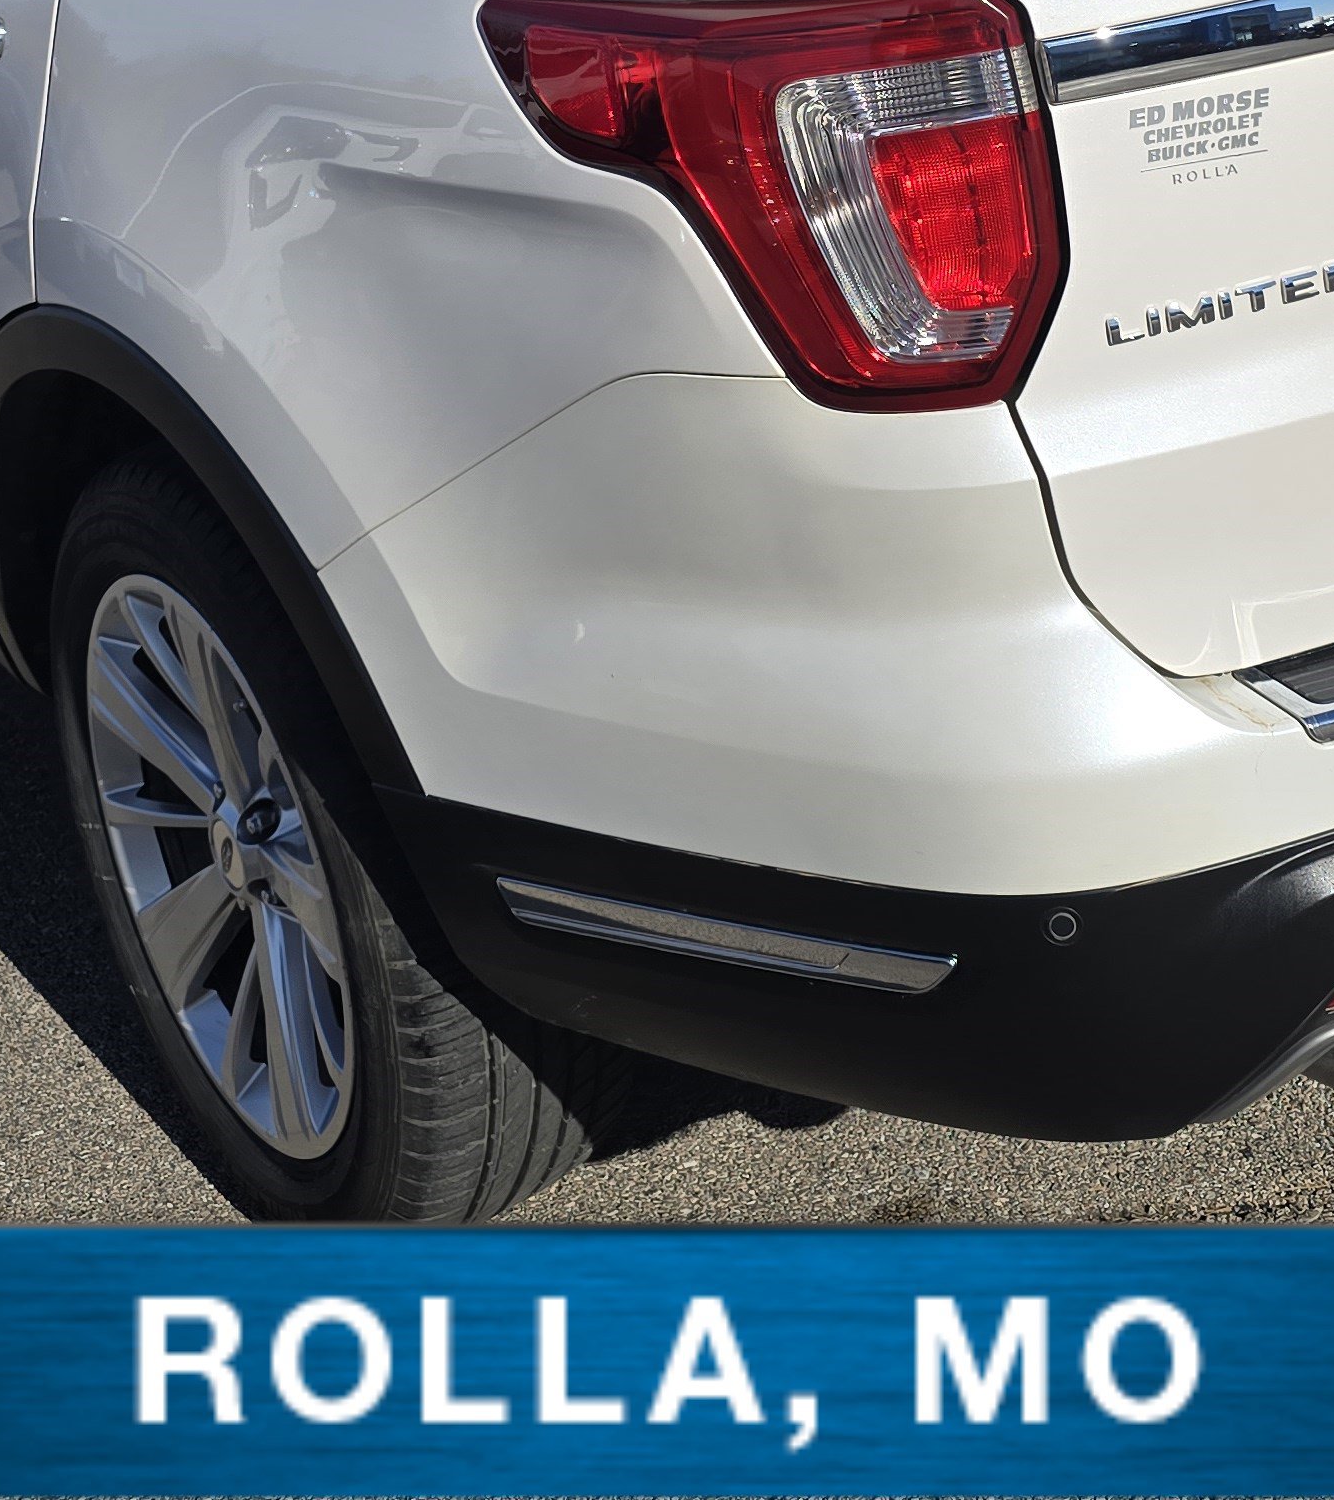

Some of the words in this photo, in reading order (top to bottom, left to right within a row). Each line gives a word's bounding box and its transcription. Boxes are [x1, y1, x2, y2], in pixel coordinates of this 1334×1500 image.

[1129, 104, 1166, 130] ED
[1172, 87, 1269, 123] MORSE
[1143, 112, 1262, 146] CHEVROLET
[1172, 164, 1238, 185] ROLLA
